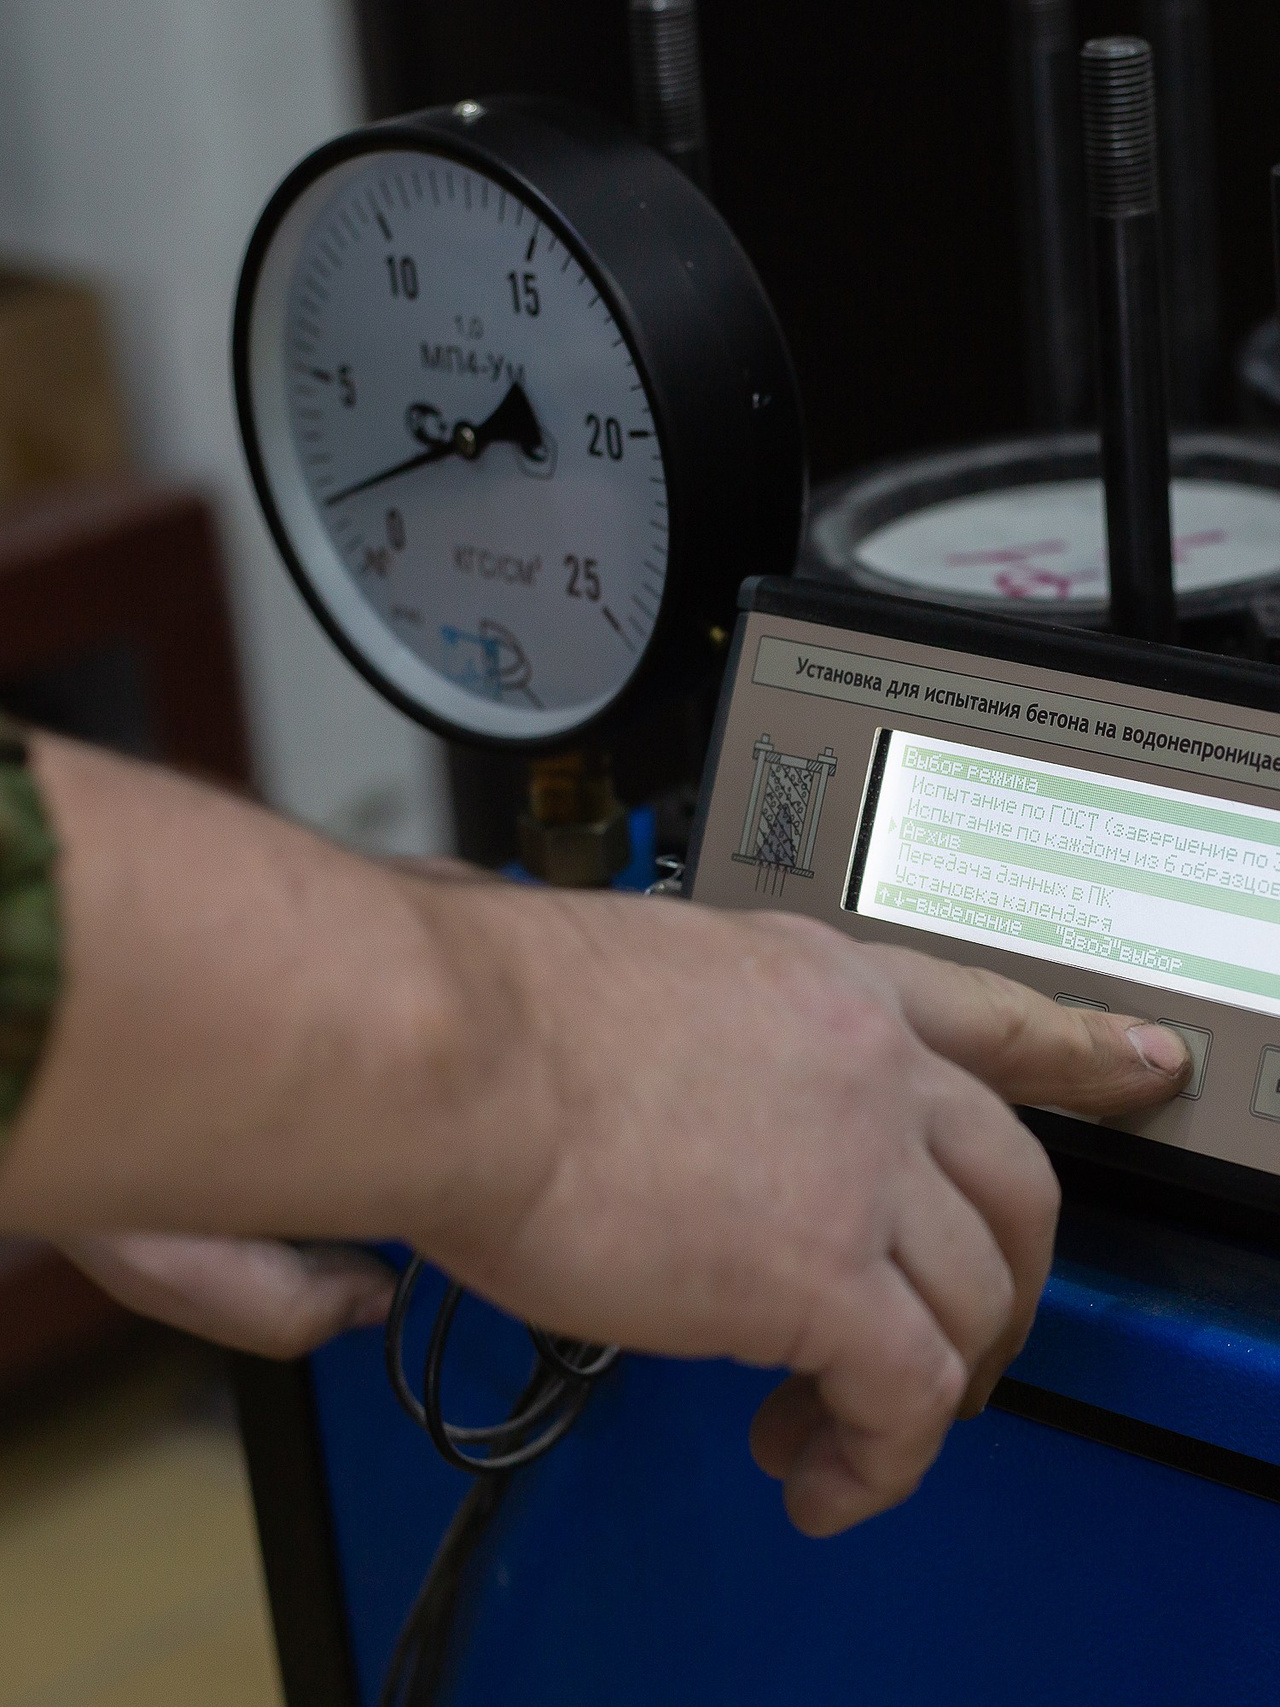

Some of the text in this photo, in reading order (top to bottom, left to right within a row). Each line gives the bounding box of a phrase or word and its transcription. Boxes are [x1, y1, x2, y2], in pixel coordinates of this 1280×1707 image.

[386, 254, 419, 300] 10
[508, 271, 541, 317] 15
[335, 364, 357, 408] 5
[585, 412, 624, 461] 20
[385, 507, 406, 550] 0
[563, 553, 600, 600] 25
[796, 656, 882, 691] Установка
[885, 679, 920, 699] для
[924, 686, 1021, 720] испытания
[1026, 703, 1089, 733] бетона
[1094, 720, 1116, 739] на
[905, 749, 1038, 793] Выбор режима
[902, 820, 961, 850] Архив
[907, 797, 1013, 838] Испытание
[1016, 826, 1041, 844] по
[1044, 832, 1131, 863] каждому
[1134, 852, 1159, 870] из
[1164, 854, 1178, 873] 6
[911, 774, 1017, 815] Испытание
[1020, 803, 1045, 821] по
[1049, 804, 1100, 832] ГОСТ
[1104, 816, 1238, 863] (завершение
[1242, 851, 1268, 869] по
[895, 864, 1113, 932] Установка календаря
[898, 842, 1115, 909] Передача данных в ПК
